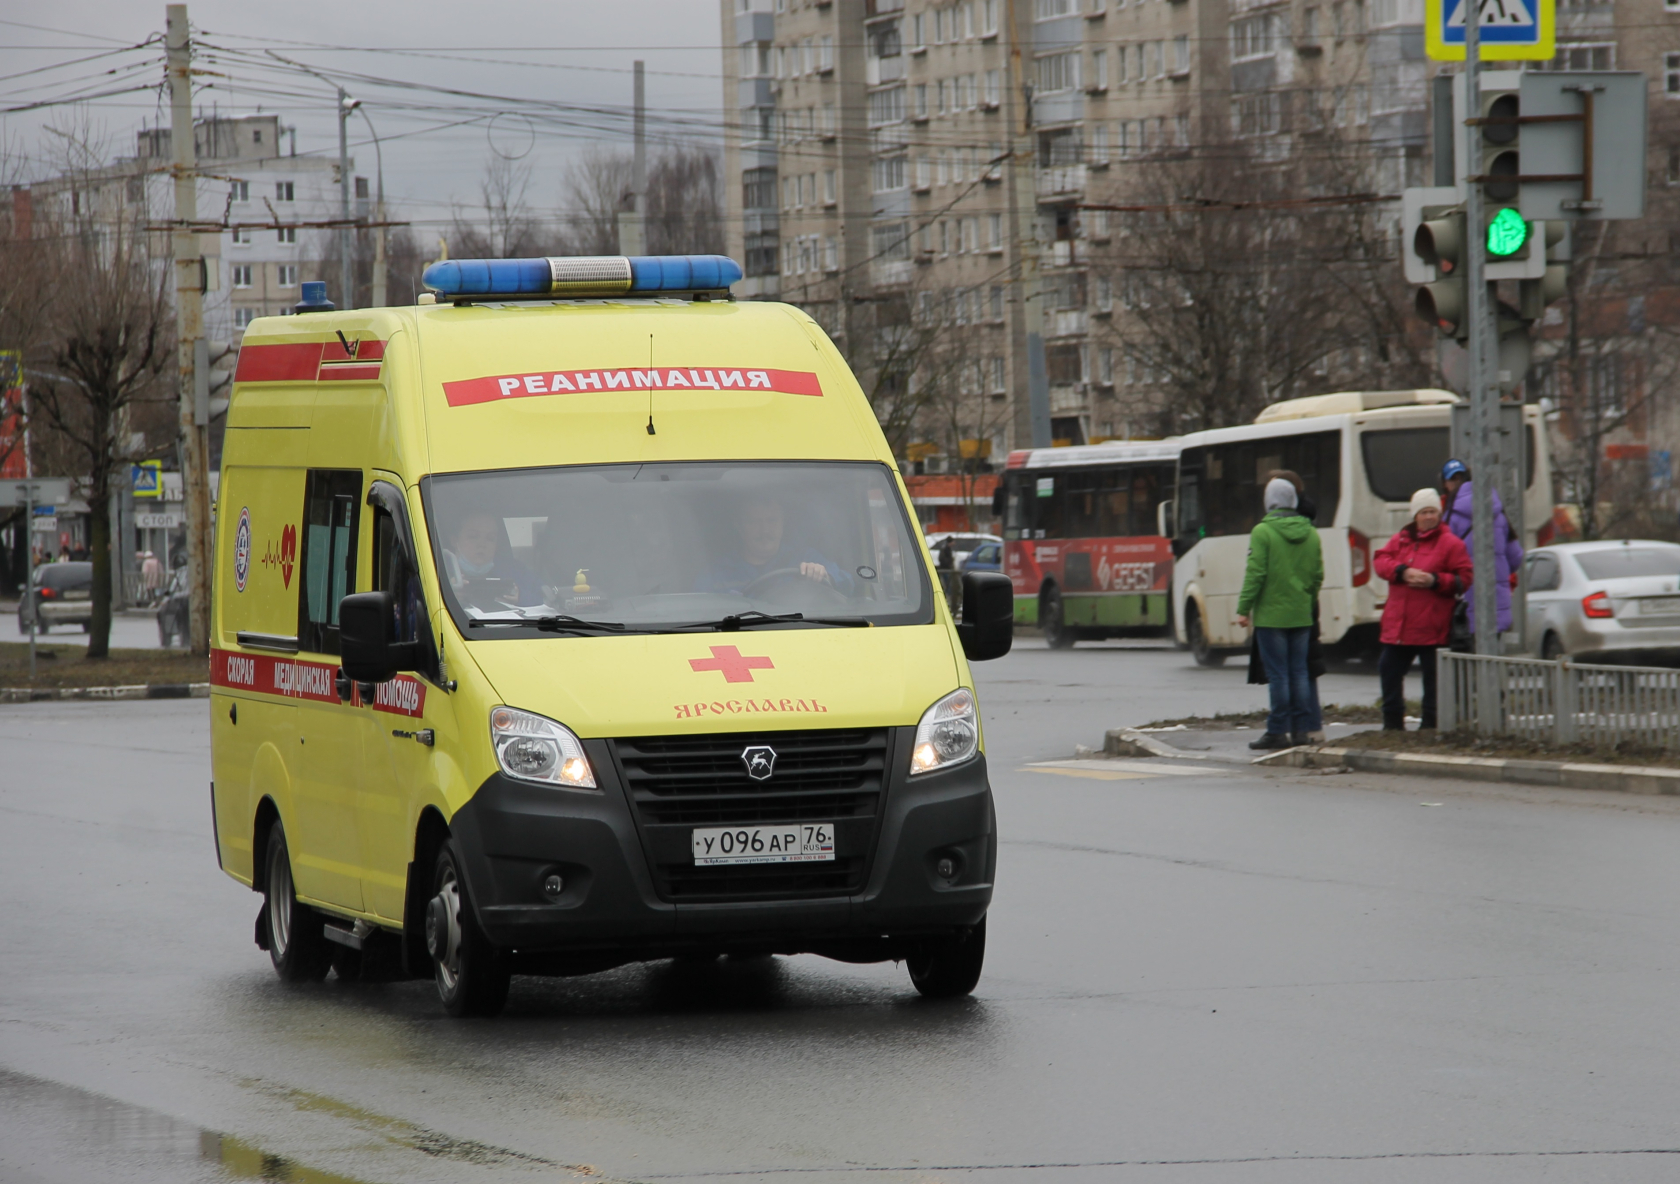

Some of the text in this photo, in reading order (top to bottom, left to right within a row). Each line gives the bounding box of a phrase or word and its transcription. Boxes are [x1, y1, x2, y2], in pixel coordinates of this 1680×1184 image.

[498, 369, 772, 396] РЕАНИМАЦИЯ
[227, 656, 419, 717] СКОРАЯ МЕДИЦИНСКАЯ ПОМОЩЬ
[673, 698, 828, 719] ЯРОСЛАВЛЬ
[804, 825, 827, 844] 76
[803, 844, 821, 852] RUS
